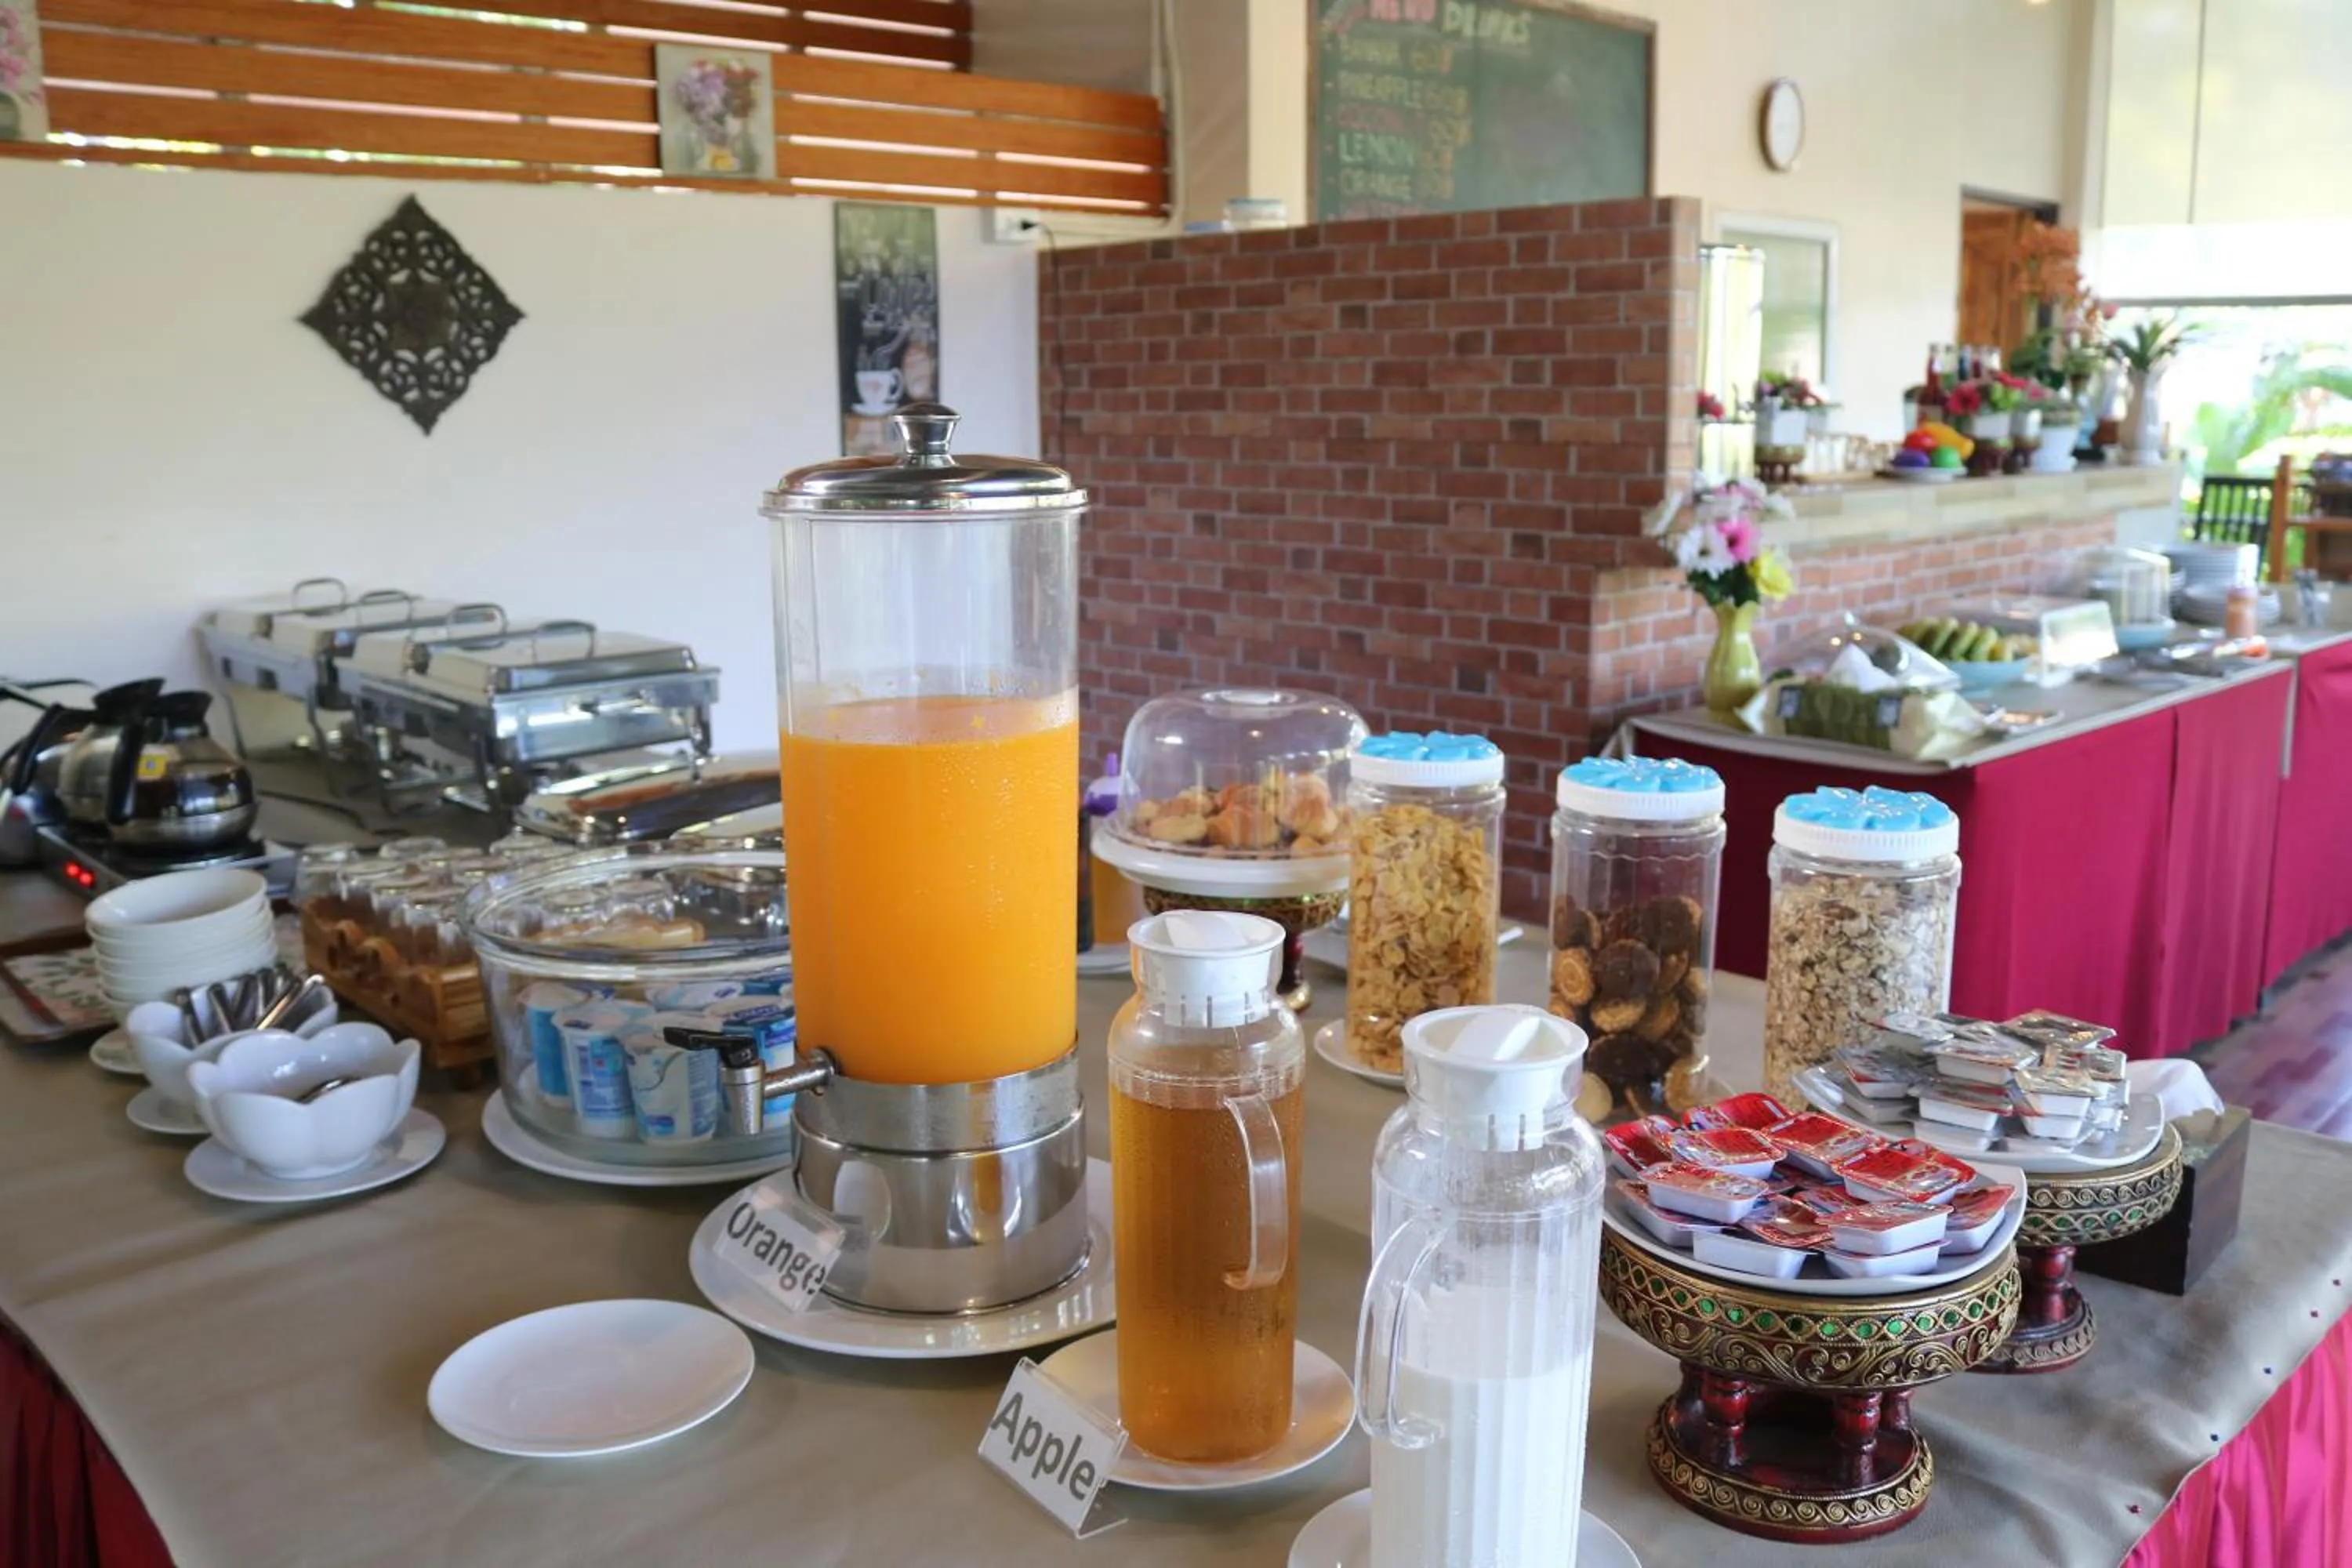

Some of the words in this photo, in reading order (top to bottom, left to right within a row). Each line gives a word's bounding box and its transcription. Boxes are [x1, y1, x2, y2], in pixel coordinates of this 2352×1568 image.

[1338, 132, 1414, 166] LEMON
[728, 1202, 826, 1295] Orange
[991, 1392, 1096, 1501] Apple
